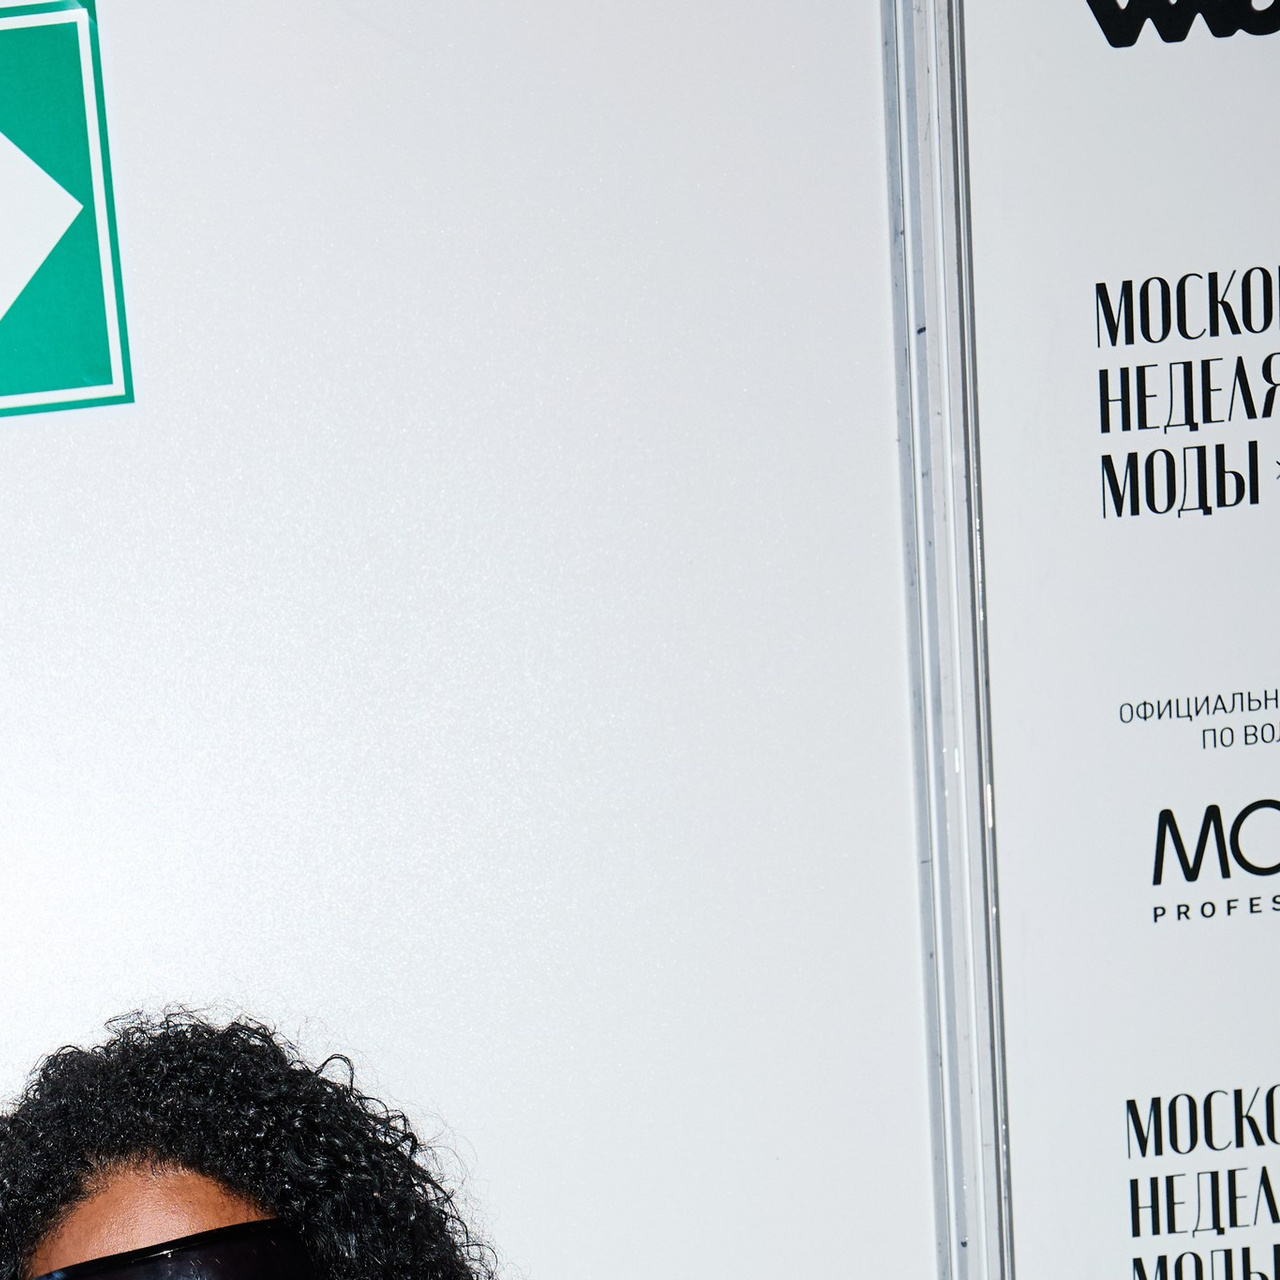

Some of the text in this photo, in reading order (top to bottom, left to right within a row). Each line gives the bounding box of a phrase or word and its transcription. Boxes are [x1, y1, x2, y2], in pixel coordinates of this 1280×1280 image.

[1095, 266, 1280, 349] МОСКО
[1101, 440, 1260, 519] МОДЫ
[1119, 688, 1279, 724] ОФИЦИАЛЬН
[1202, 722, 1280, 750] ПО ВО
[1129, 1165, 1280, 1238] НЕДЕЛ
